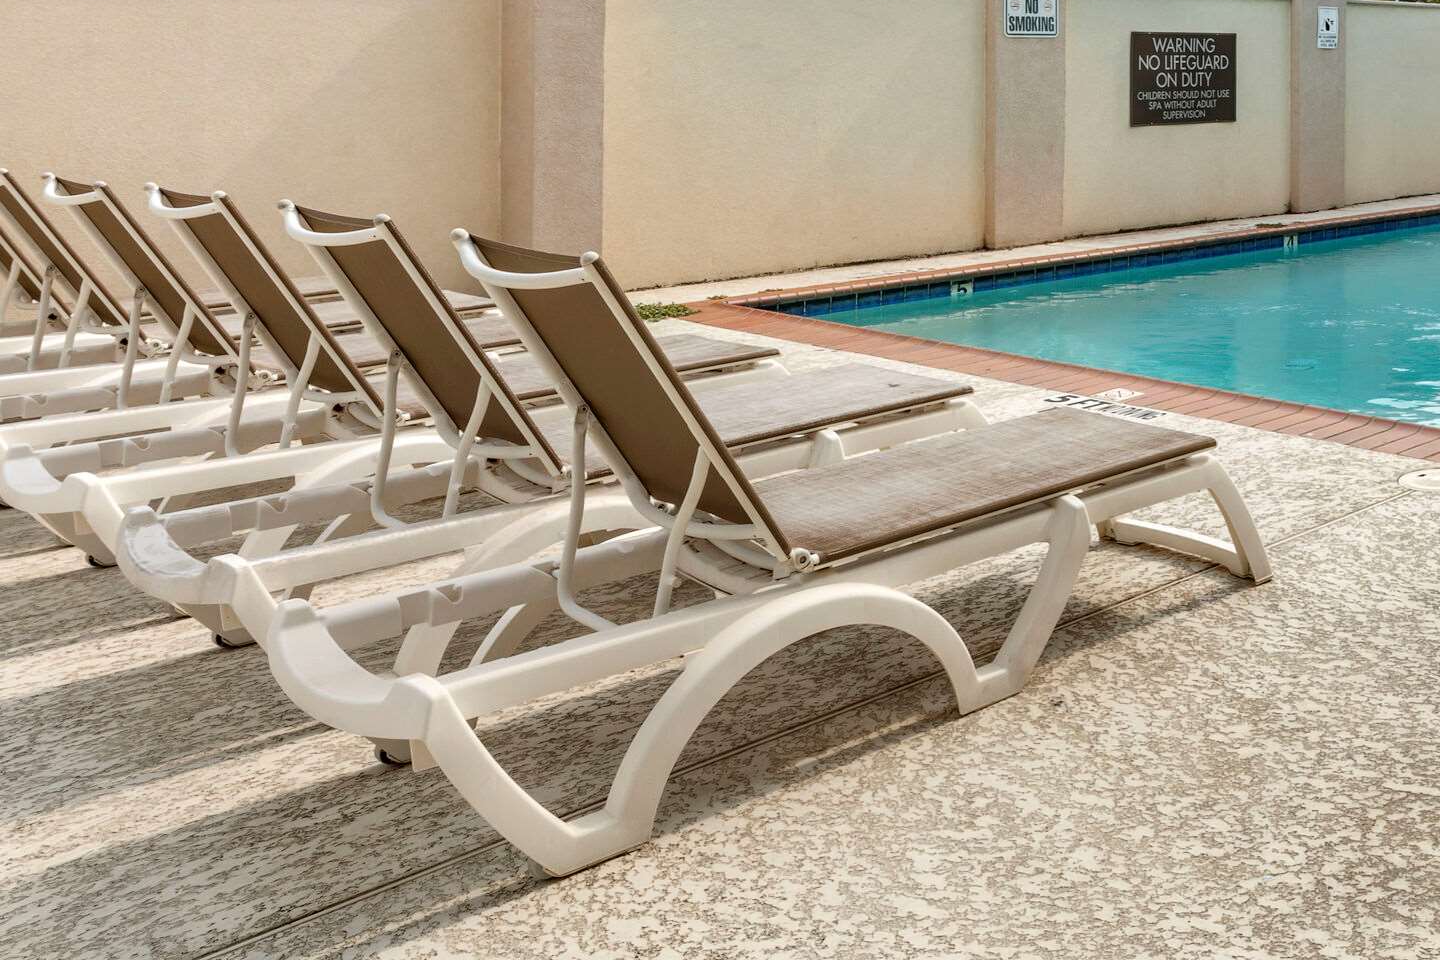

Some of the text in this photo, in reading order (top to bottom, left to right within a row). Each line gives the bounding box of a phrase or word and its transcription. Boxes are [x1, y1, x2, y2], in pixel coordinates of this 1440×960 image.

[1009, 16, 1055, 32] SMOKING
[1152, 37, 1216, 53] WARNING
[1138, 54, 1229, 71] NO LIFEGUARD
[1156, 71, 1213, 88] ON DUTY
[1137, 89, 1230, 101] CHILDREN SHOULD NOT USE
[1148, 99, 1217, 111] SPA WITHOUT ADULT
[1162, 109, 1206, 120] SUPERVISION
[1043, 394, 1080, 403] 5
[1067, 398, 1113, 410] FT
